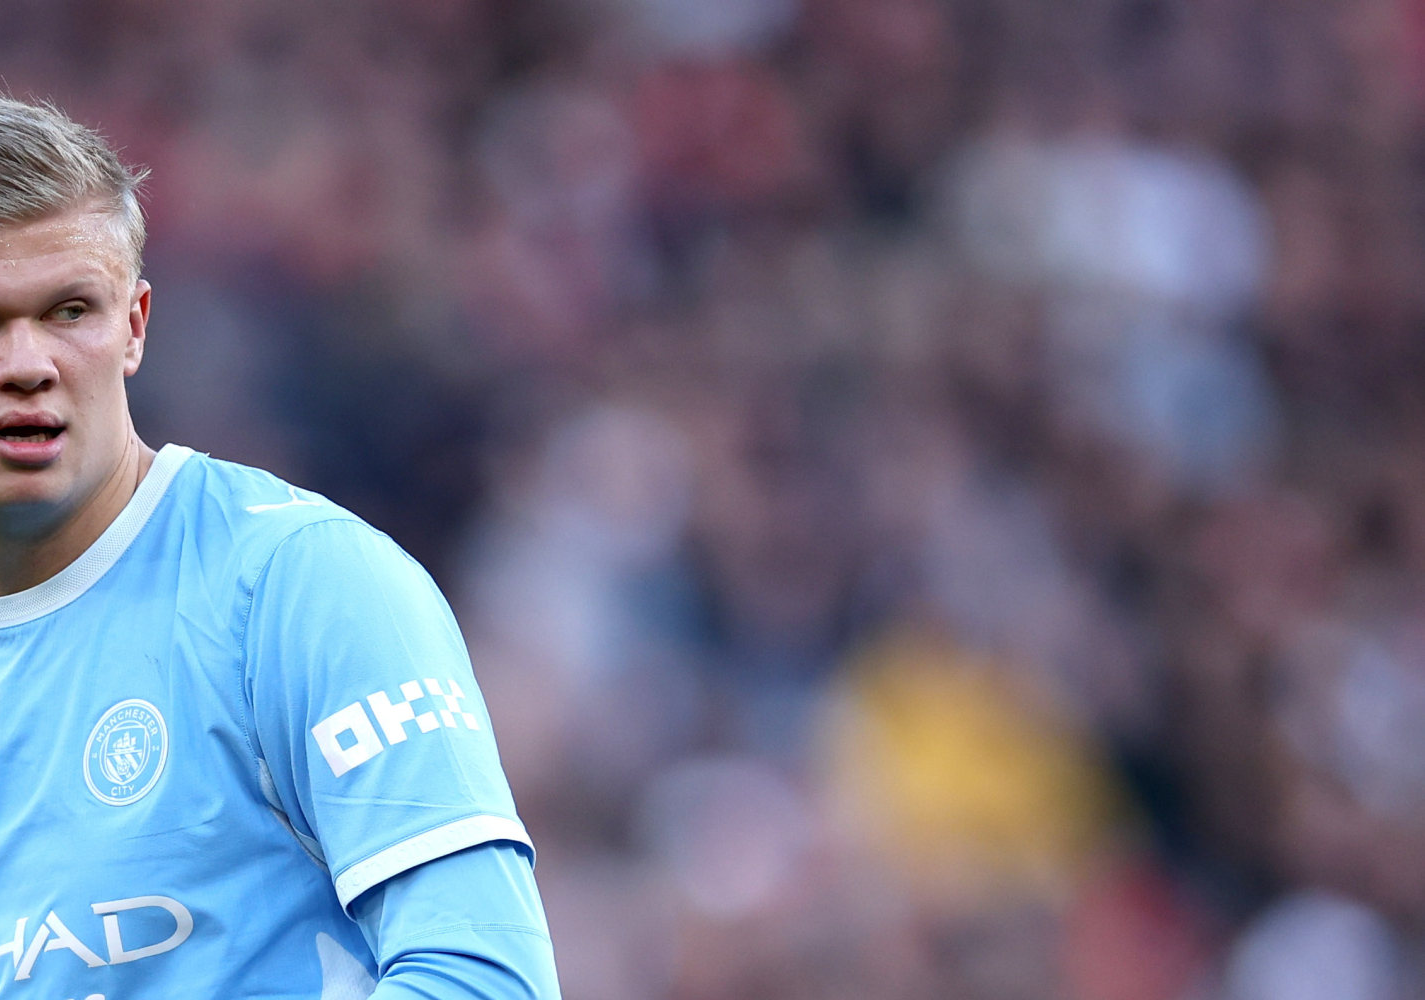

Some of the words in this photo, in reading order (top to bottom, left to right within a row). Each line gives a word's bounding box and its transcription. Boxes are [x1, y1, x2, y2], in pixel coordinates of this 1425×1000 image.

[96, 708, 159, 743] MANCHESTER
[311, 678, 480, 778] OKX
[110, 785, 135, 796] CITY
